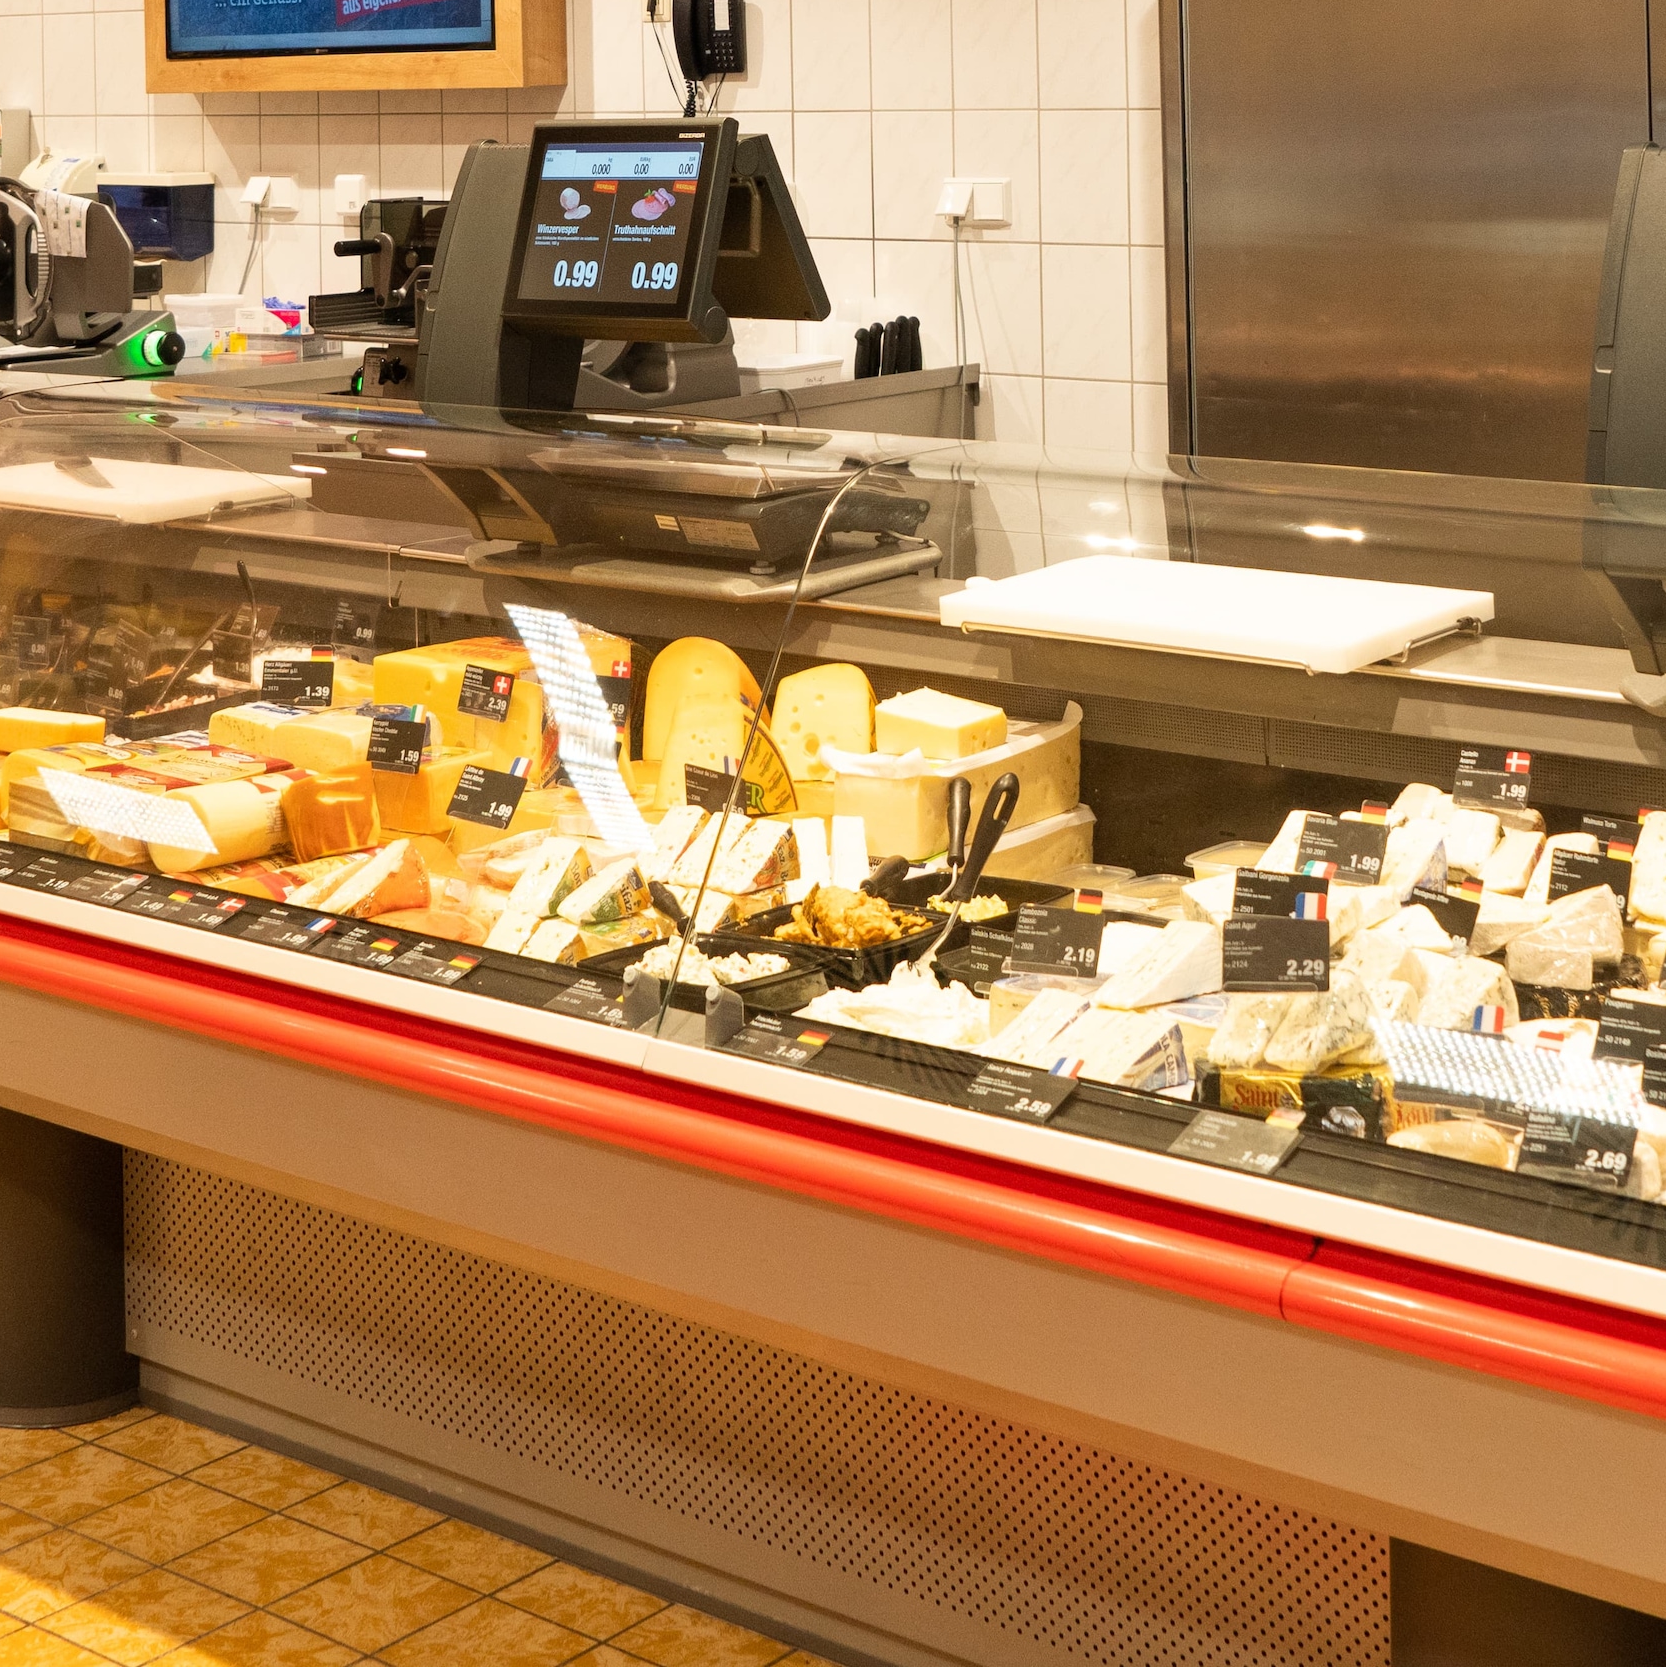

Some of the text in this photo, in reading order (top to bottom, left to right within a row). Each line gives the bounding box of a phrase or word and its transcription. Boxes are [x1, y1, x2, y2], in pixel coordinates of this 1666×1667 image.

[342, 0, 361, 15] aus
[592, 163, 694, 175] 0,000 0,00 0,00
[537, 223, 579, 235] Winzervesper
[614, 225, 676, 236] Truthahnaufschnitt
[553, 260, 599, 288] 0.99
[632, 262, 678, 289] 0.99
[304, 685, 331, 698] 1.39
[488, 697, 507, 711] 2.39
[400, 749, 419, 762] 1.59
[1460, 749, 1479, 759] Castello
[1499, 783, 1527, 799] 1.99
[489, 801, 513, 817] 1.99
[1306, 815, 1338, 826] Bavaria Blue
[1350, 854, 1381, 871] 1.99
[1237, 869, 1290, 883] Galbani Gorgonzola
[1019, 907, 1048, 917] Cambozola
[1240, 905, 1254, 914] 2501
[1018, 916, 1037, 925] Classic
[1225, 921, 1257, 932] Saint Agur
[280, 931, 308, 946] 1.99
[365, 951, 395, 966] 1.99
[1063, 946, 1096, 964] 2.19
[1232, 960, 1248, 969] 2124
[1286, 959, 1325, 977] 2.29
[432, 965, 462, 980] 1.99
[775, 1044, 807, 1061] 1.59
[1234, 1082, 1278, 1107] Saint
[1014, 1097, 1052, 1113] 2.59
[1240, 1150, 1279, 1169] 1.99
[1584, 1148, 1628, 1171] 2.69
